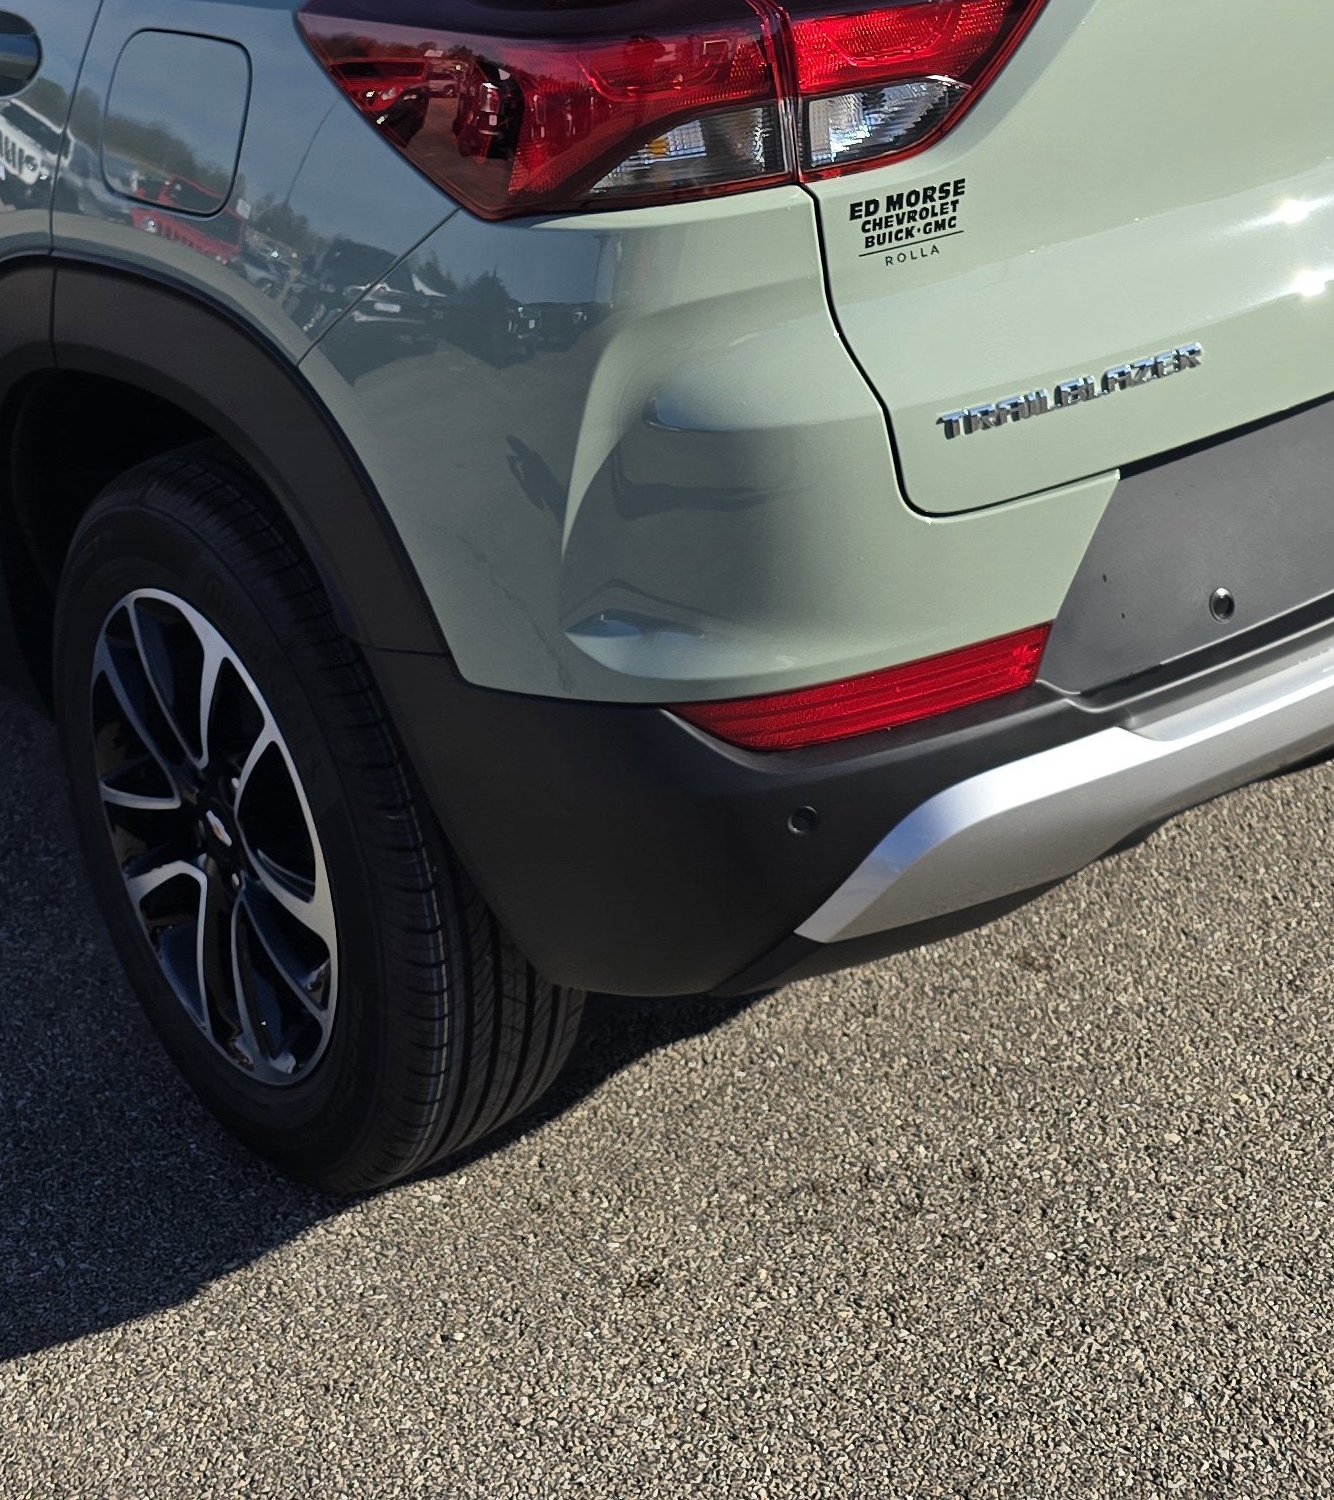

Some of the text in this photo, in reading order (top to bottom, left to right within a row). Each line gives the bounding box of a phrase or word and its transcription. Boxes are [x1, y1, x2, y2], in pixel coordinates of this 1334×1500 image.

[849, 178, 966, 221] ED MORSE
[861, 199, 960, 233] CHEVROLET
[885, 244, 940, 266] ROLLA
[935, 341, 1204, 440] TRAILBLAZER
